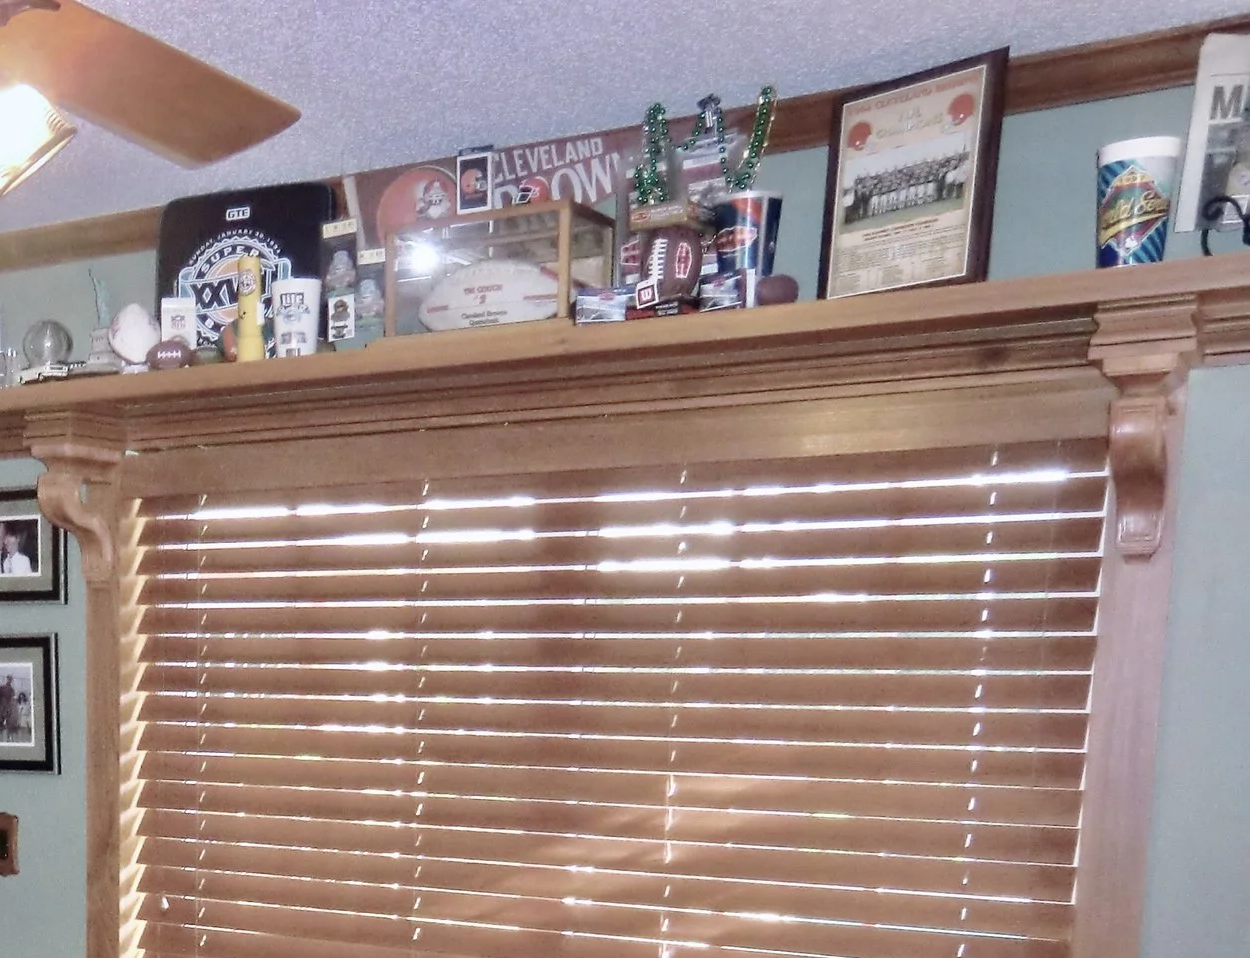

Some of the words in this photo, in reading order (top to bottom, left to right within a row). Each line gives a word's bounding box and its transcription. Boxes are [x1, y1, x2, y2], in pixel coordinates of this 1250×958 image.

[492, 138, 603, 184] CLEVELAND
[227, 208, 249, 219] GTE
[201, 245, 260, 274] SUPER
